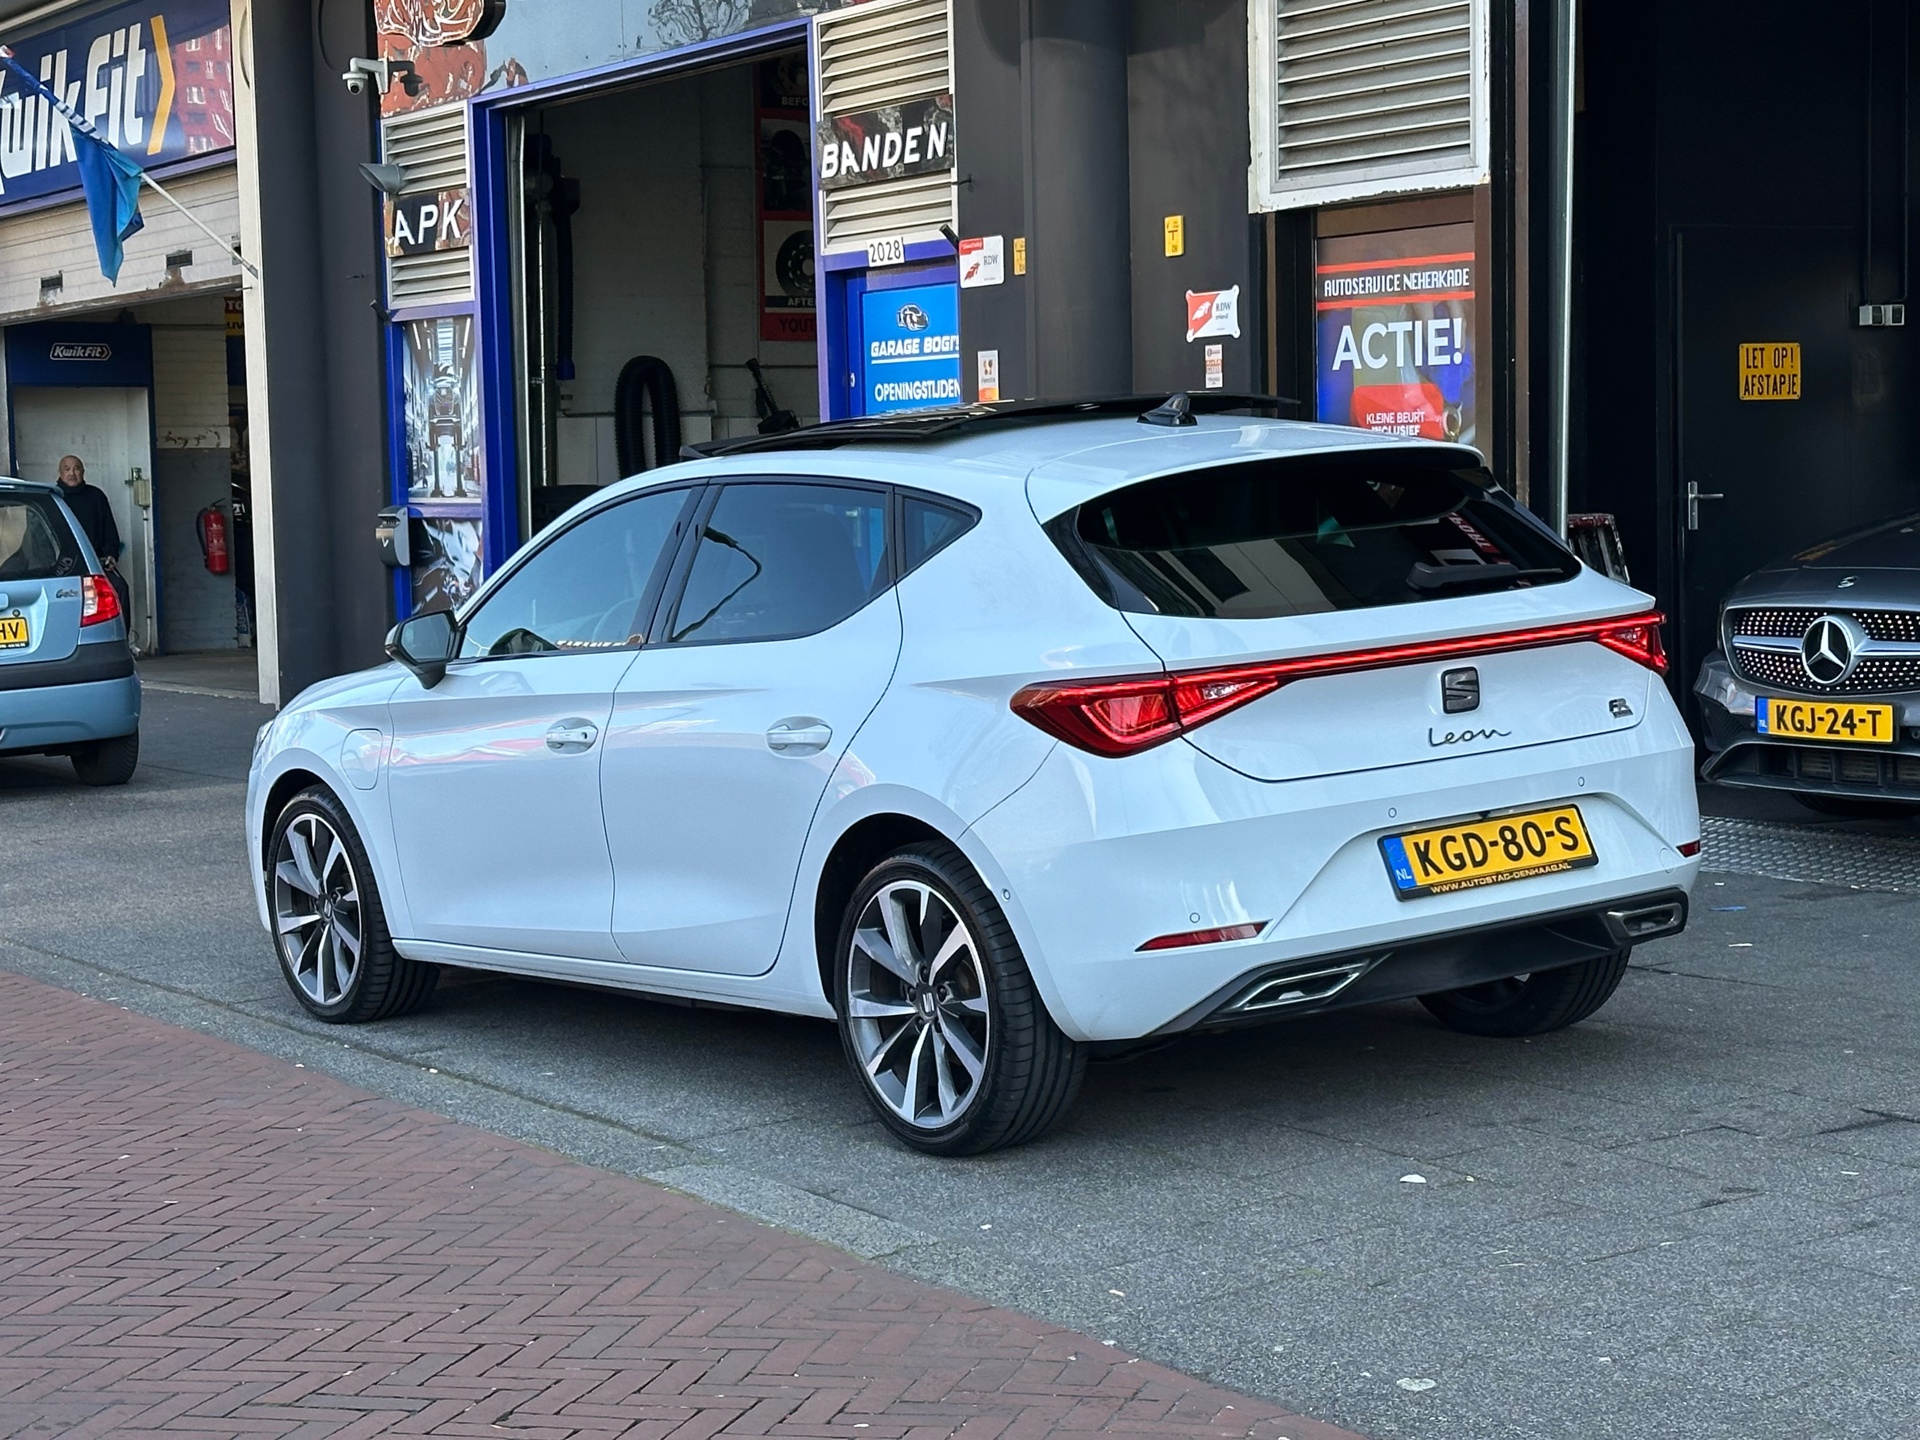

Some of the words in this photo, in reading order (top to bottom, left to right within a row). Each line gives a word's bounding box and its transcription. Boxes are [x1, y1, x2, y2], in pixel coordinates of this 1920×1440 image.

[821, 122, 947, 178] BANDEN
[394, 199, 464, 246] APK
[869, 239, 901, 263] 2028
[983, 254, 999, 266] RDW
[1324, 274, 1400, 297] AUTOSERVICE
[1403, 268, 1470, 290] NEHERKADE
[1216, 302, 1232, 311] RDW
[871, 338, 921, 357] GARAGE
[1332, 318, 1463, 371] ACTIE!
[1745, 347, 1766, 369] LET
[1773, 347, 1794, 369] OP!
[875, 379, 961, 402] OPENINGSTIJDEN
[1743, 374, 1798, 396] AFSTAPJE
[1366, 412, 1396, 425] KLEINE
[1397, 411, 1426, 423] BEURT
[1776, 704, 1882, 737] KGJ-24-T
[1428, 727, 1512, 747] Leon
[1395, 869, 1413, 881] NL
[1413, 816, 1579, 877] KGD-80-S
